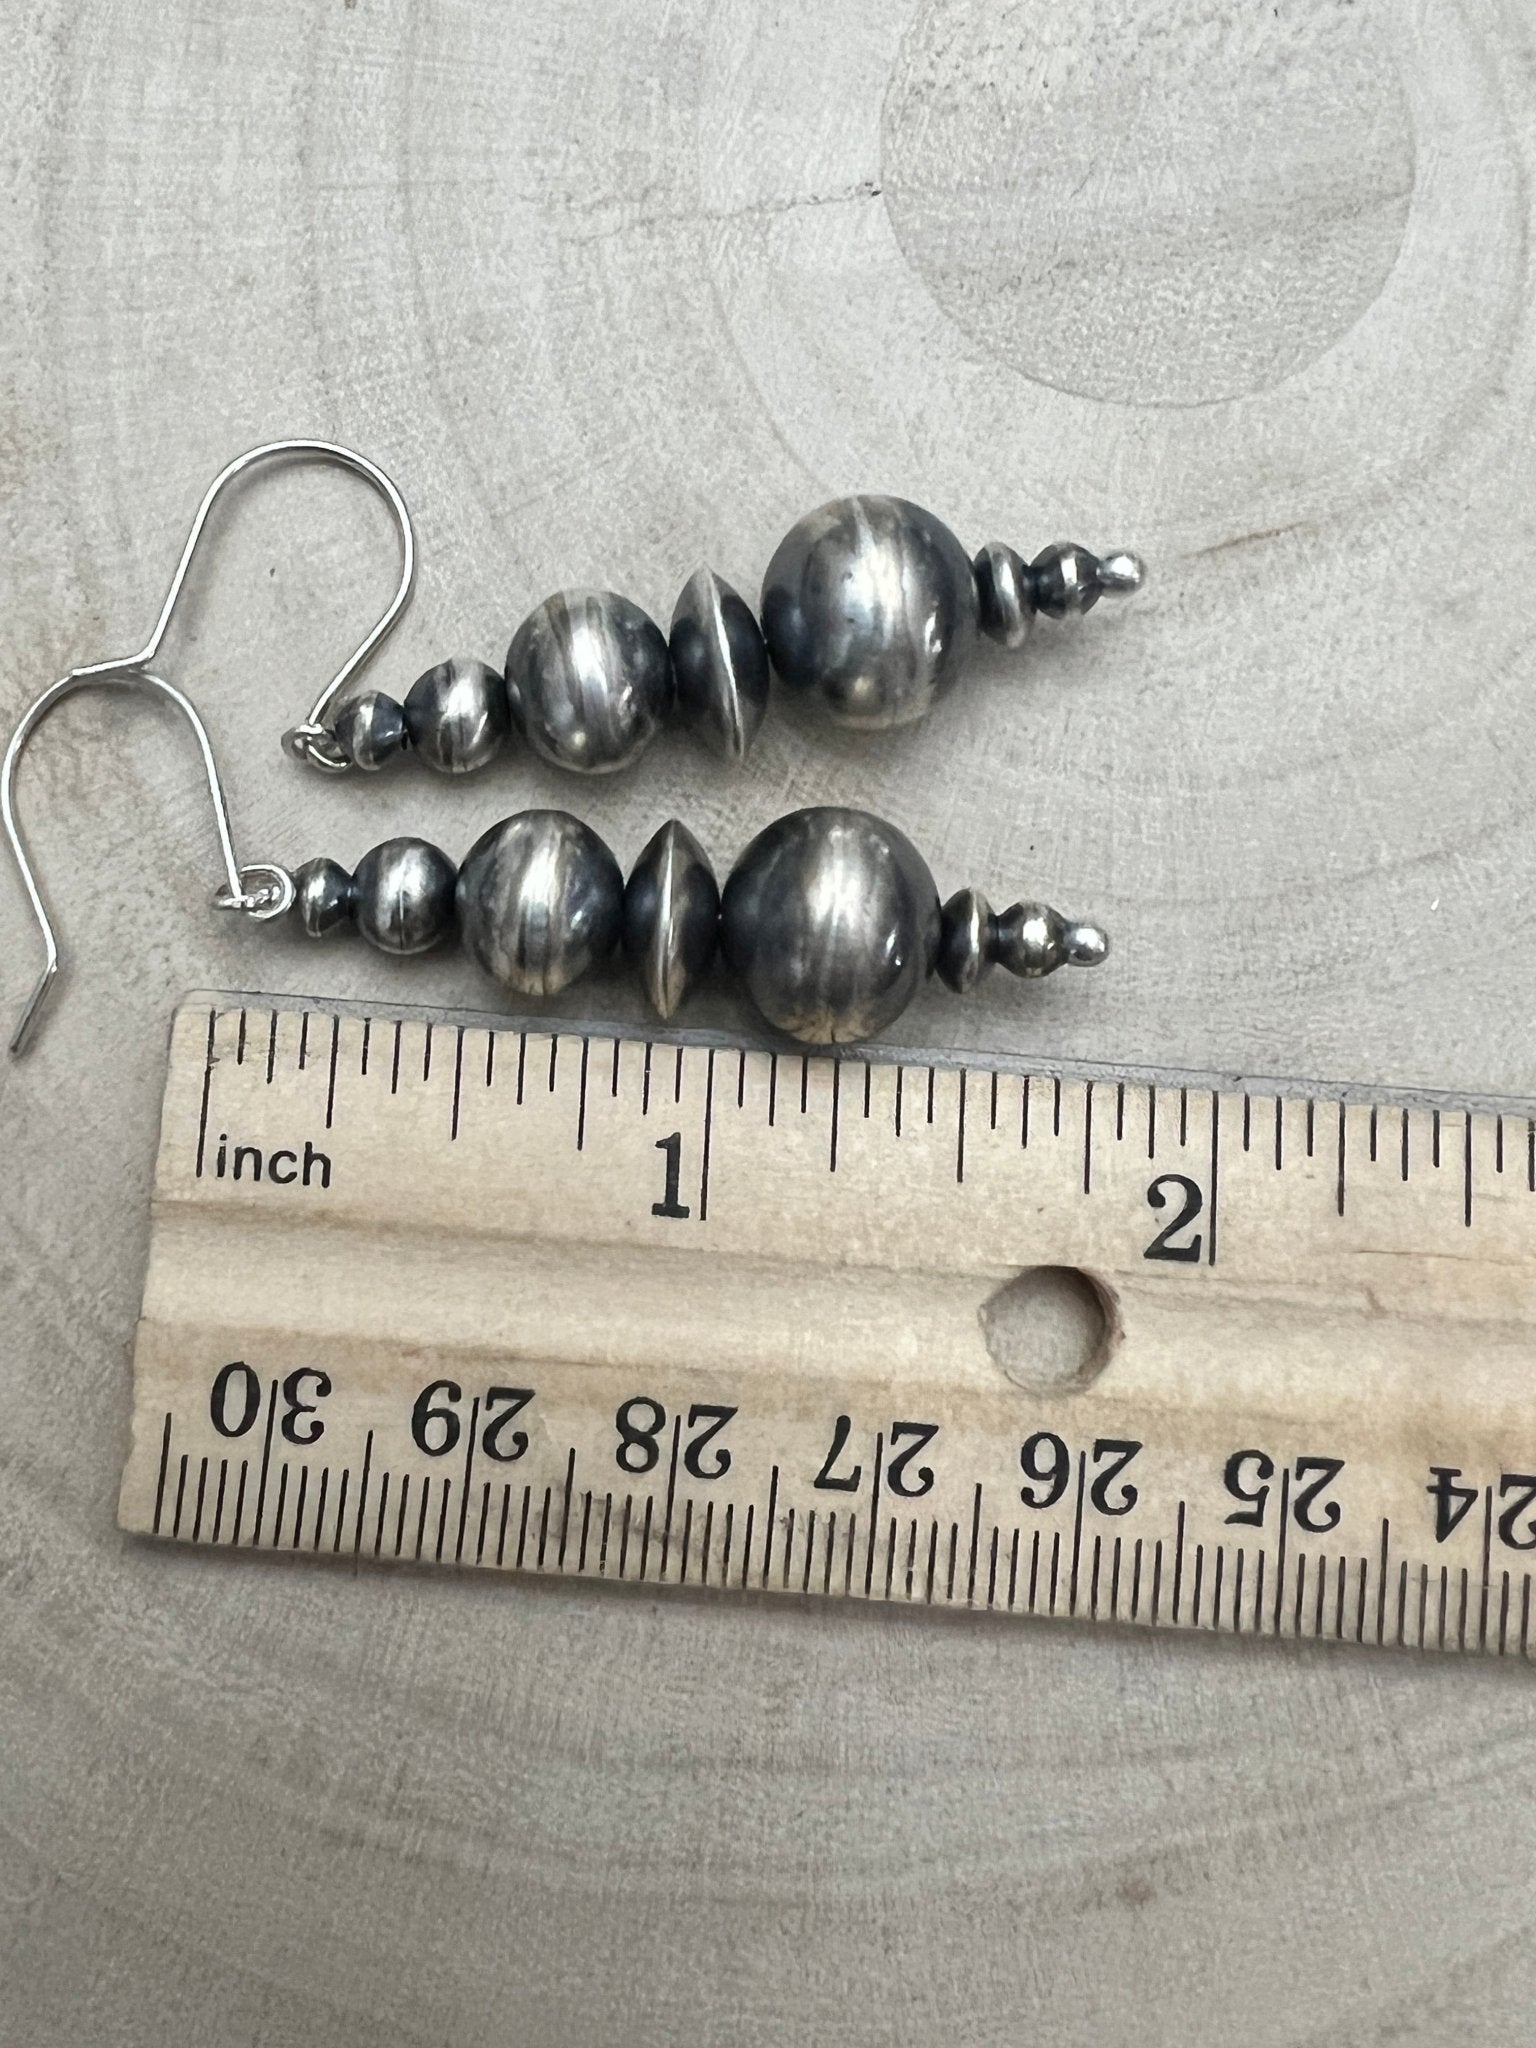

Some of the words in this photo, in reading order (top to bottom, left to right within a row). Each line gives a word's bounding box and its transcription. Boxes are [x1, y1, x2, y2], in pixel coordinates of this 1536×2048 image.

[216, 1134, 332, 1188] inch
[651, 1131, 690, 1219] 1
[1143, 1173, 1204, 1263] 2
[210, 1361, 332, 1445] 30
[411, 1379, 536, 1461] 29
[615, 1396, 738, 1479] 28
[814, 1415, 939, 1498] 27
[1020, 1432, 1143, 1515] 26
[1224, 1450, 1346, 1533] 25
